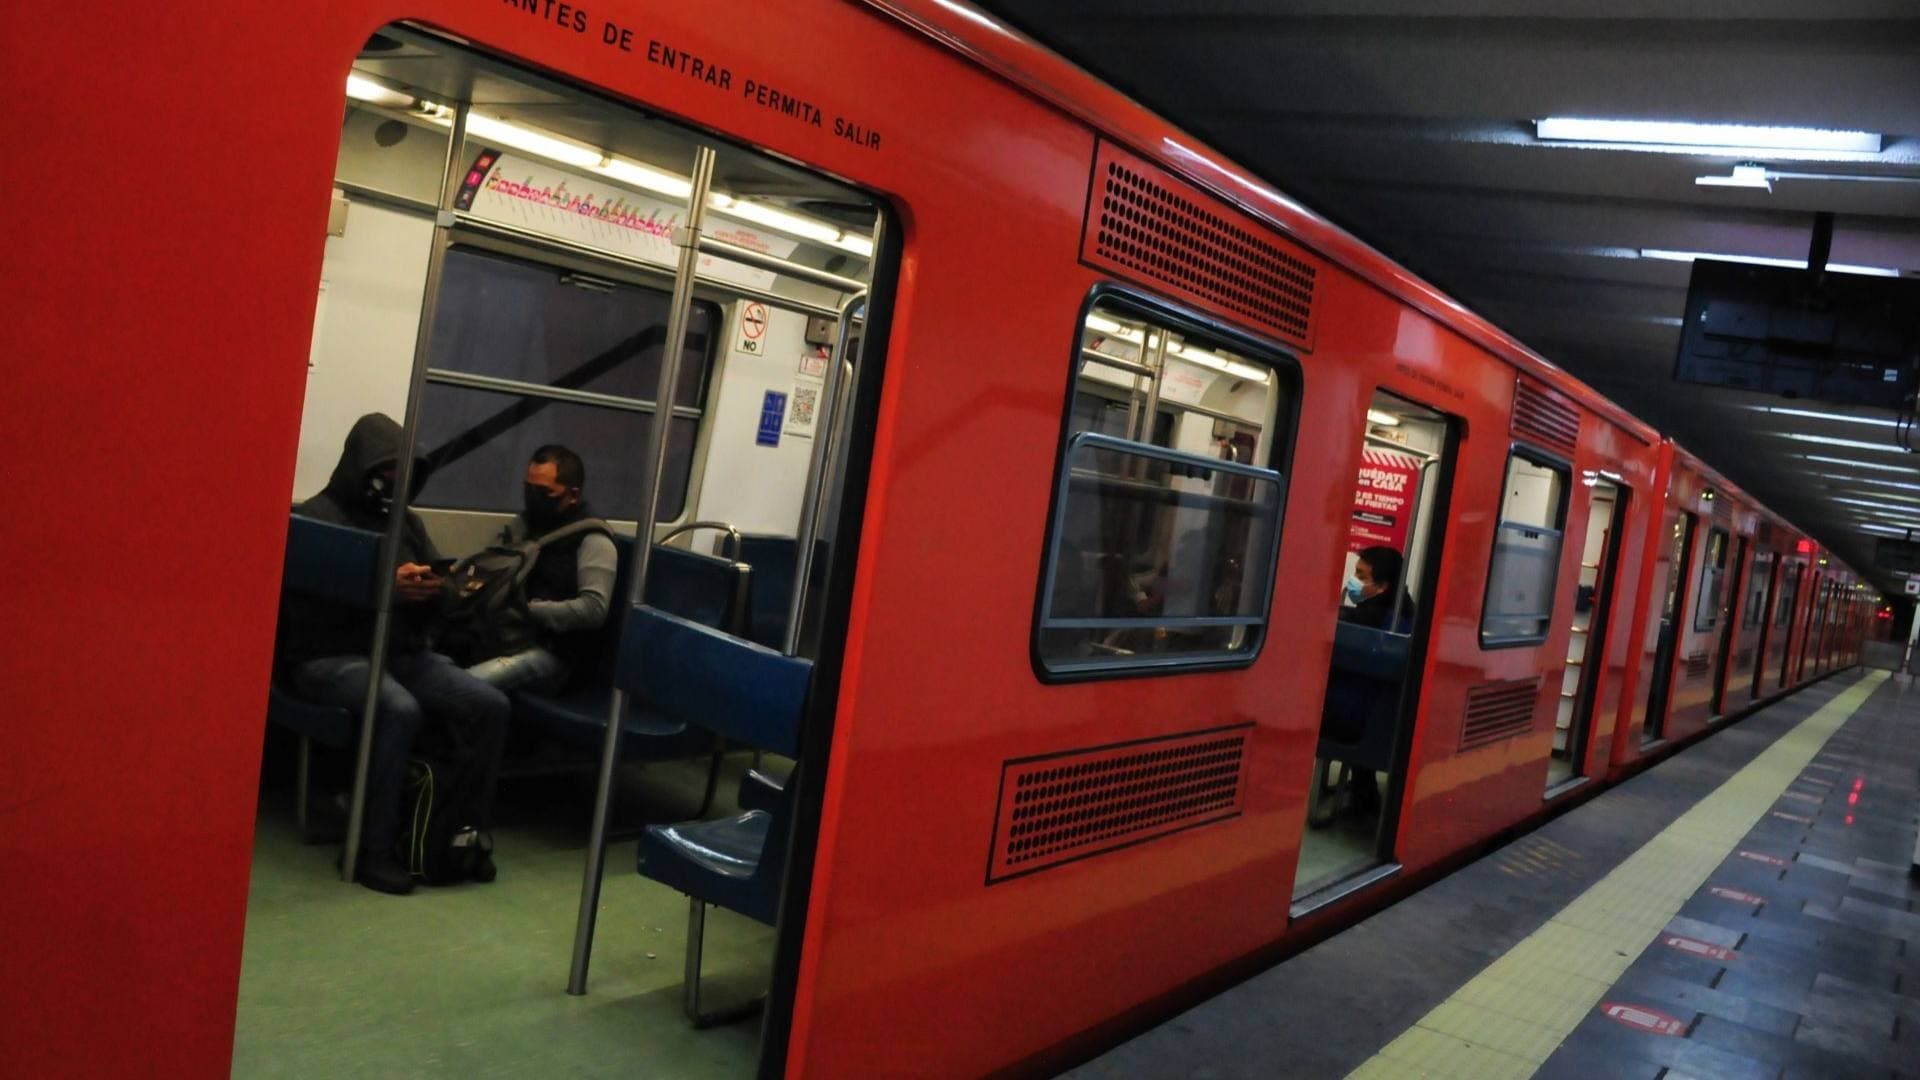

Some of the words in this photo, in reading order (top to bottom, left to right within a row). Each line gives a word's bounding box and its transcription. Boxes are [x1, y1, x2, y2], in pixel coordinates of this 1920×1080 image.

[503, 0, 586, 33] NTES
[603, 22, 634, 52] DE
[647, 40, 732, 90] ENTRAR
[744, 80, 823, 128] PERMITA
[834, 118, 881, 151] SALIR
[743, 339, 757, 352] NO
[1372, 478, 1406, 493] CASA
